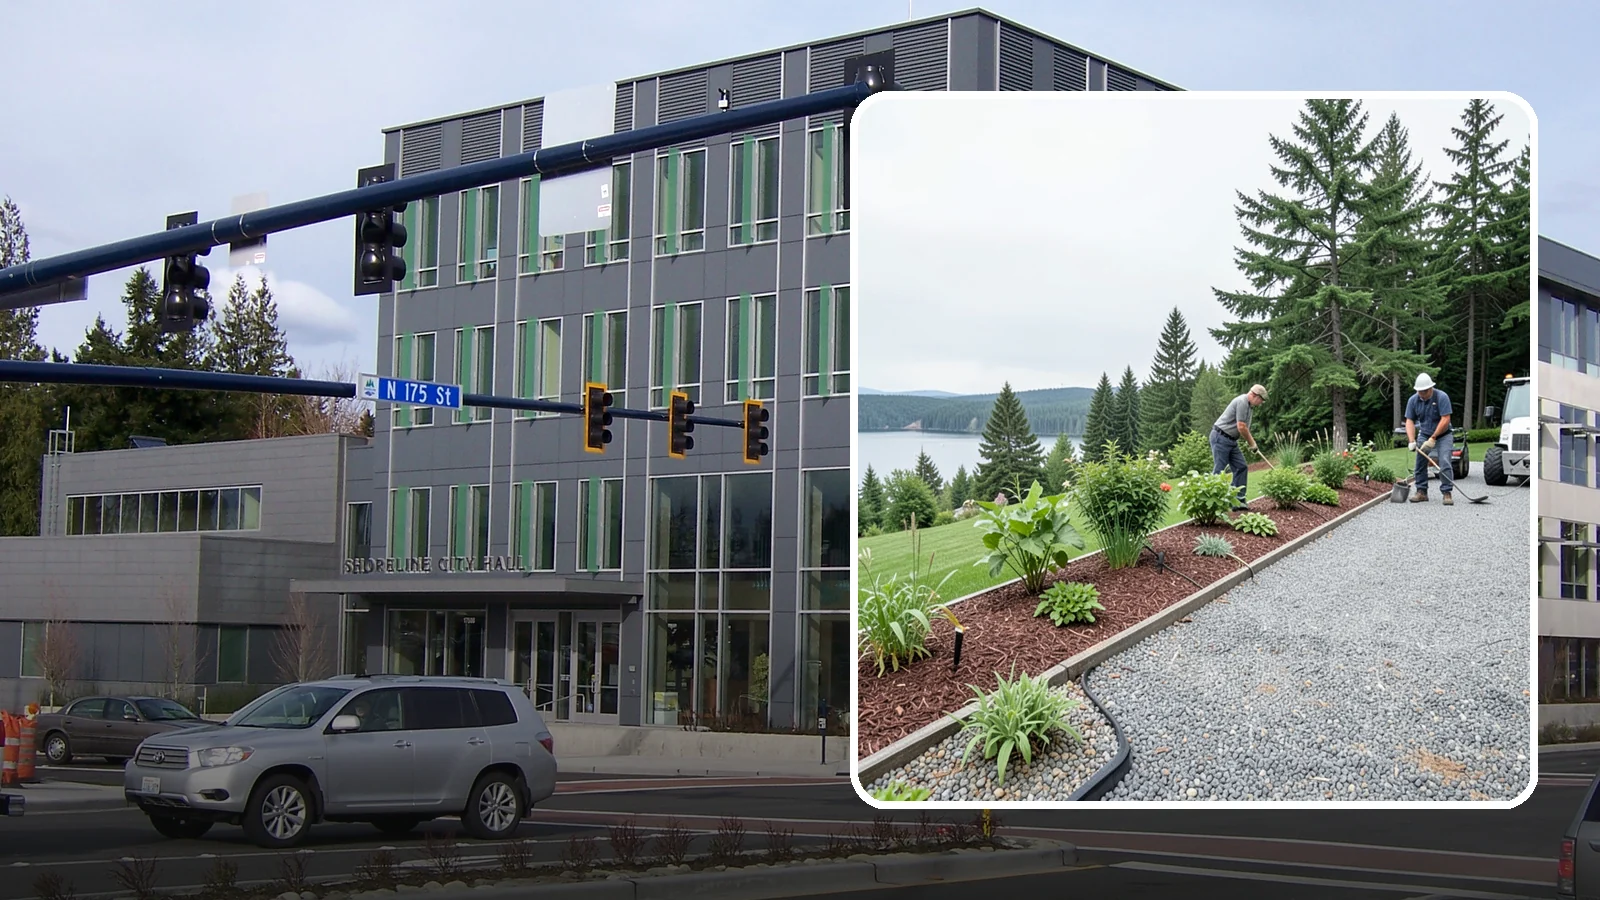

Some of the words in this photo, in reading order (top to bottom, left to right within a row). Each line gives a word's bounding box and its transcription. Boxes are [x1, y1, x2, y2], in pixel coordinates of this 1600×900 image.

[387, 380, 396, 400] N
[405, 382, 427, 403] 175
[436, 386, 451, 406] St
[344, 556, 432, 574] SHORELINE
[438, 556, 476, 572] CITY
[483, 555, 526, 572] HALL
